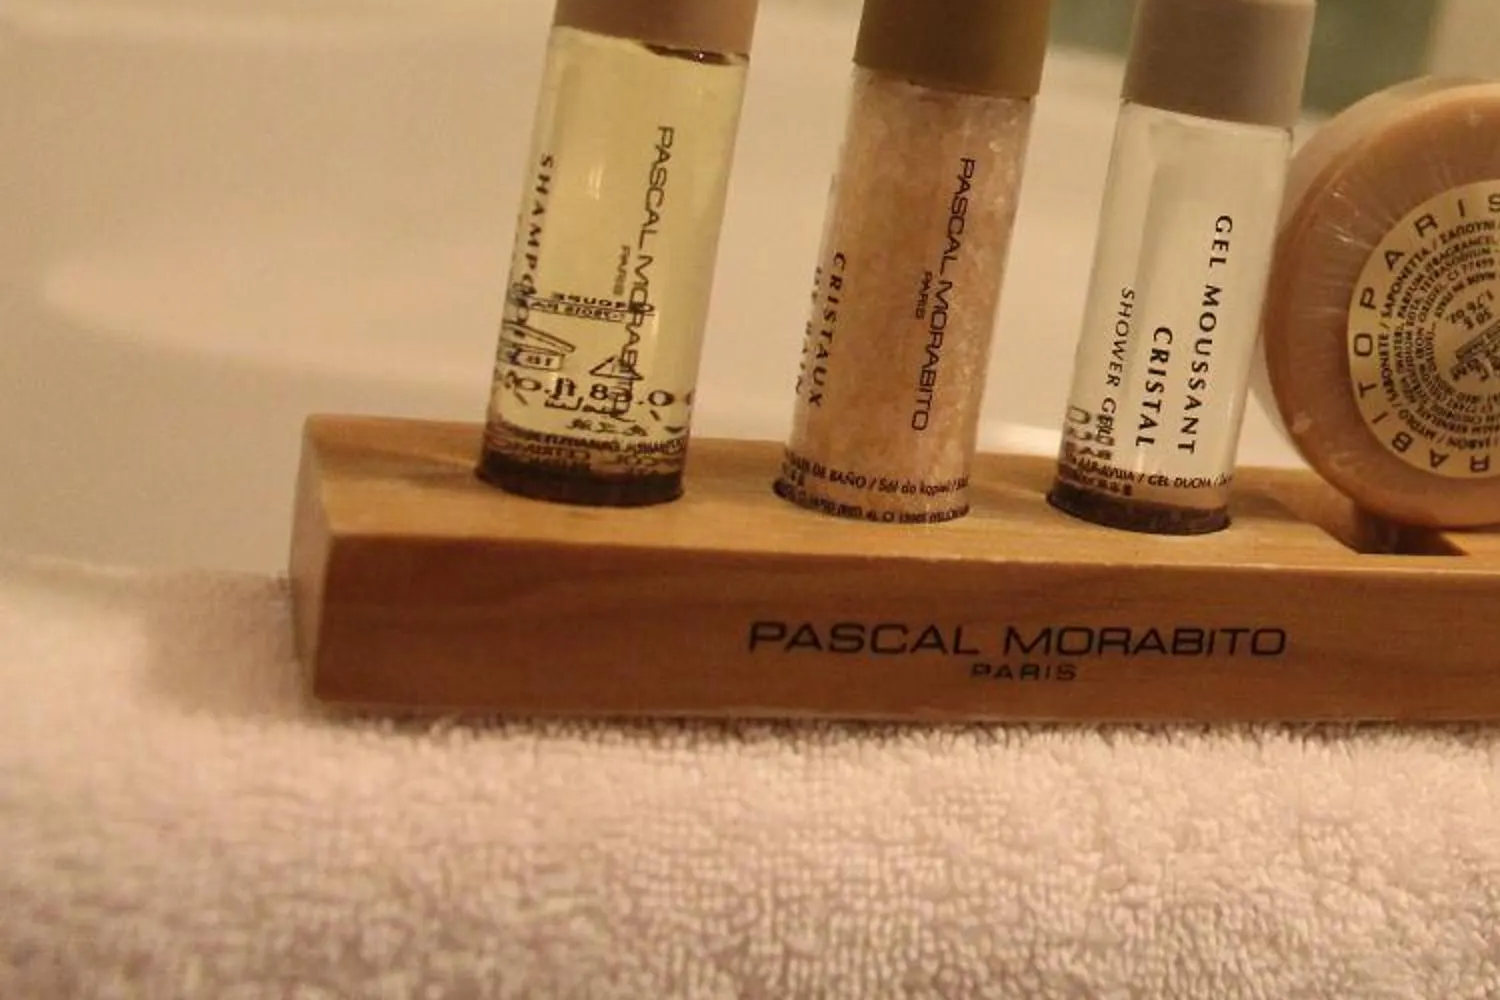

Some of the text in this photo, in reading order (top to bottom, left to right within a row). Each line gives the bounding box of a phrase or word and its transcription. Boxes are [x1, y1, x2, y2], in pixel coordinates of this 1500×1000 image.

[637, 125, 675, 250] PASCAL
[1209, 214, 1234, 268] GEL
[807, 250, 847, 408] CRISTAUX
[911, 157, 976, 432] PASCAL MORABITO
[914, 270, 933, 321] PARIS
[1105, 286, 1136, 389] SHOWER
[1135, 325, 1174, 448] CRISTAL
[1177, 284, 1224, 454] MOUSSANT
[748, 621, 1287, 657] PASCAL MORABITO
[970, 663, 1078, 682] PARIS
